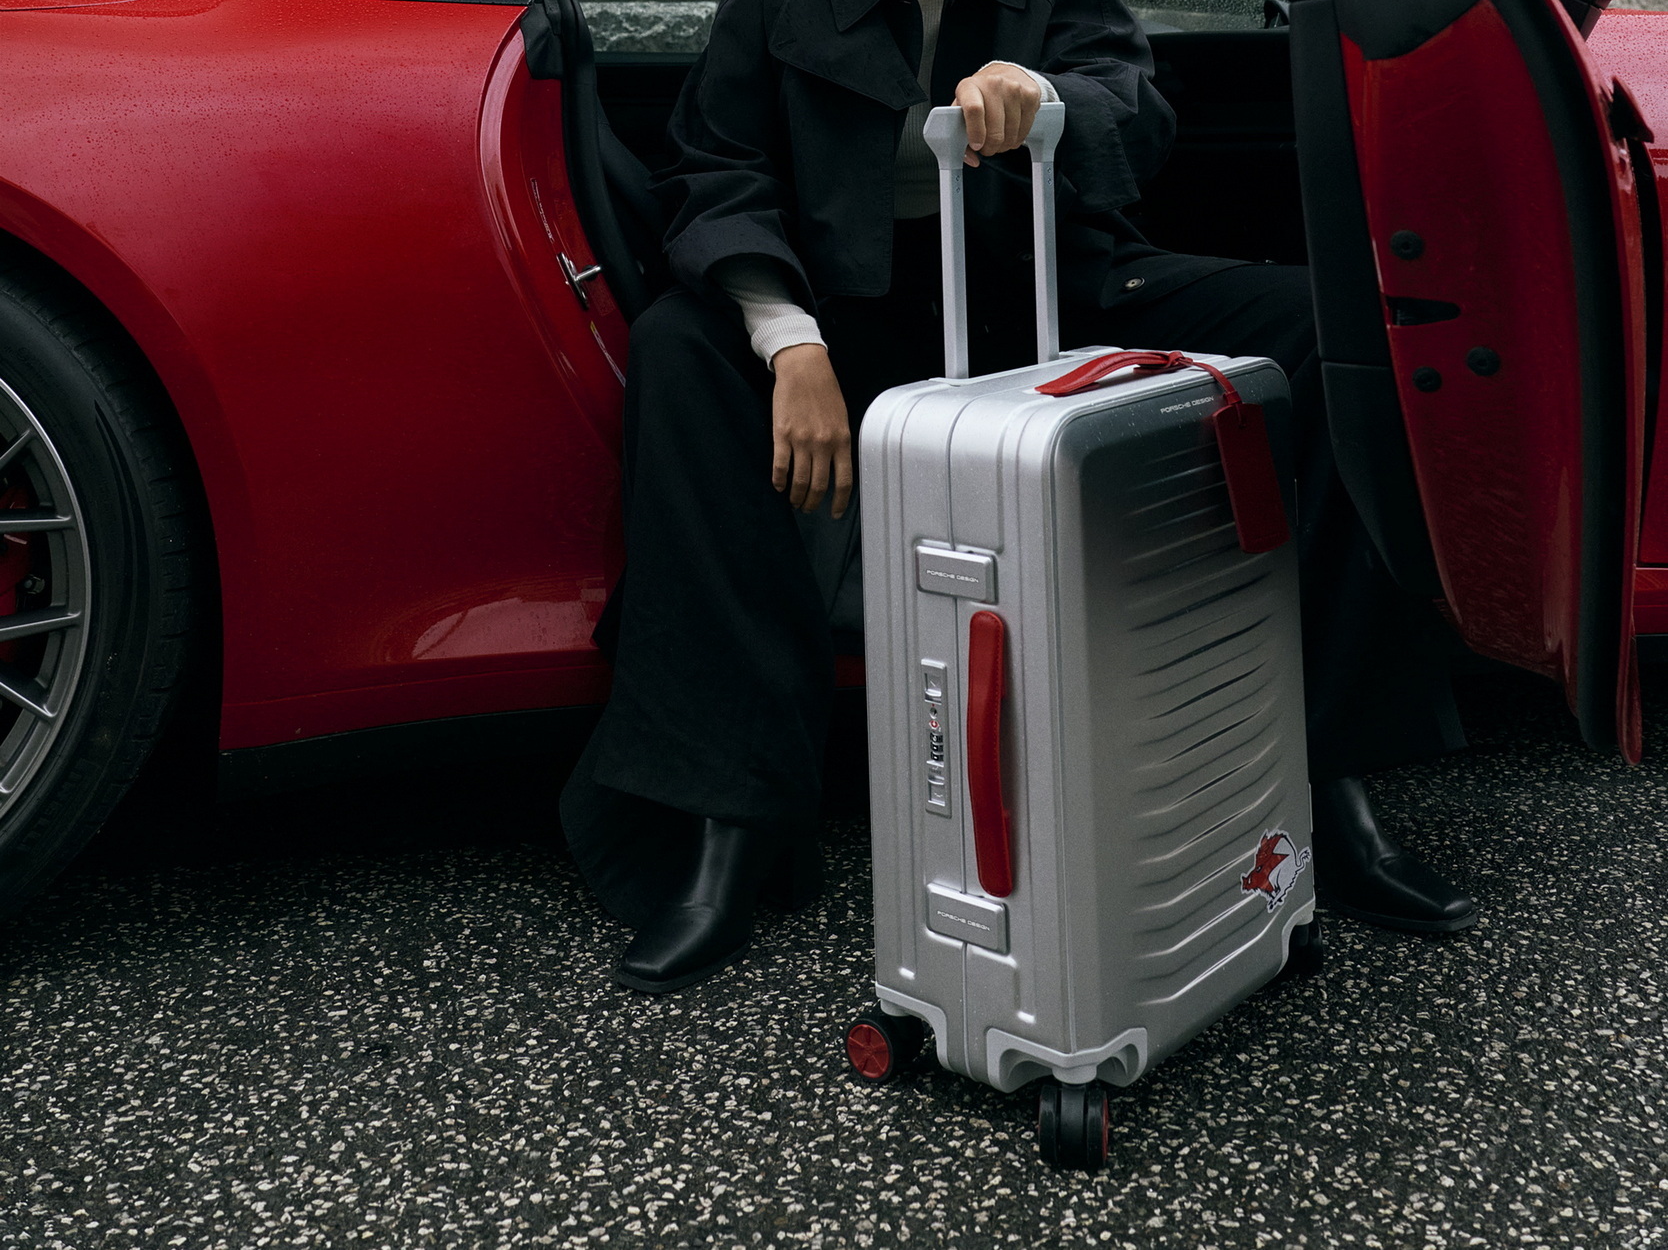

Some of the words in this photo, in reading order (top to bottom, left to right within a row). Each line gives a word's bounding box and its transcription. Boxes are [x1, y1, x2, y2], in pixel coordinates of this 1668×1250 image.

[1160, 401, 1191, 414] PORSCHE
[1191, 396, 1214, 406] DESIGN
[926, 569, 955, 579] PORSCHE
[956, 574, 979, 583] DESIGN
[937, 910, 966, 924] PORSCHE
